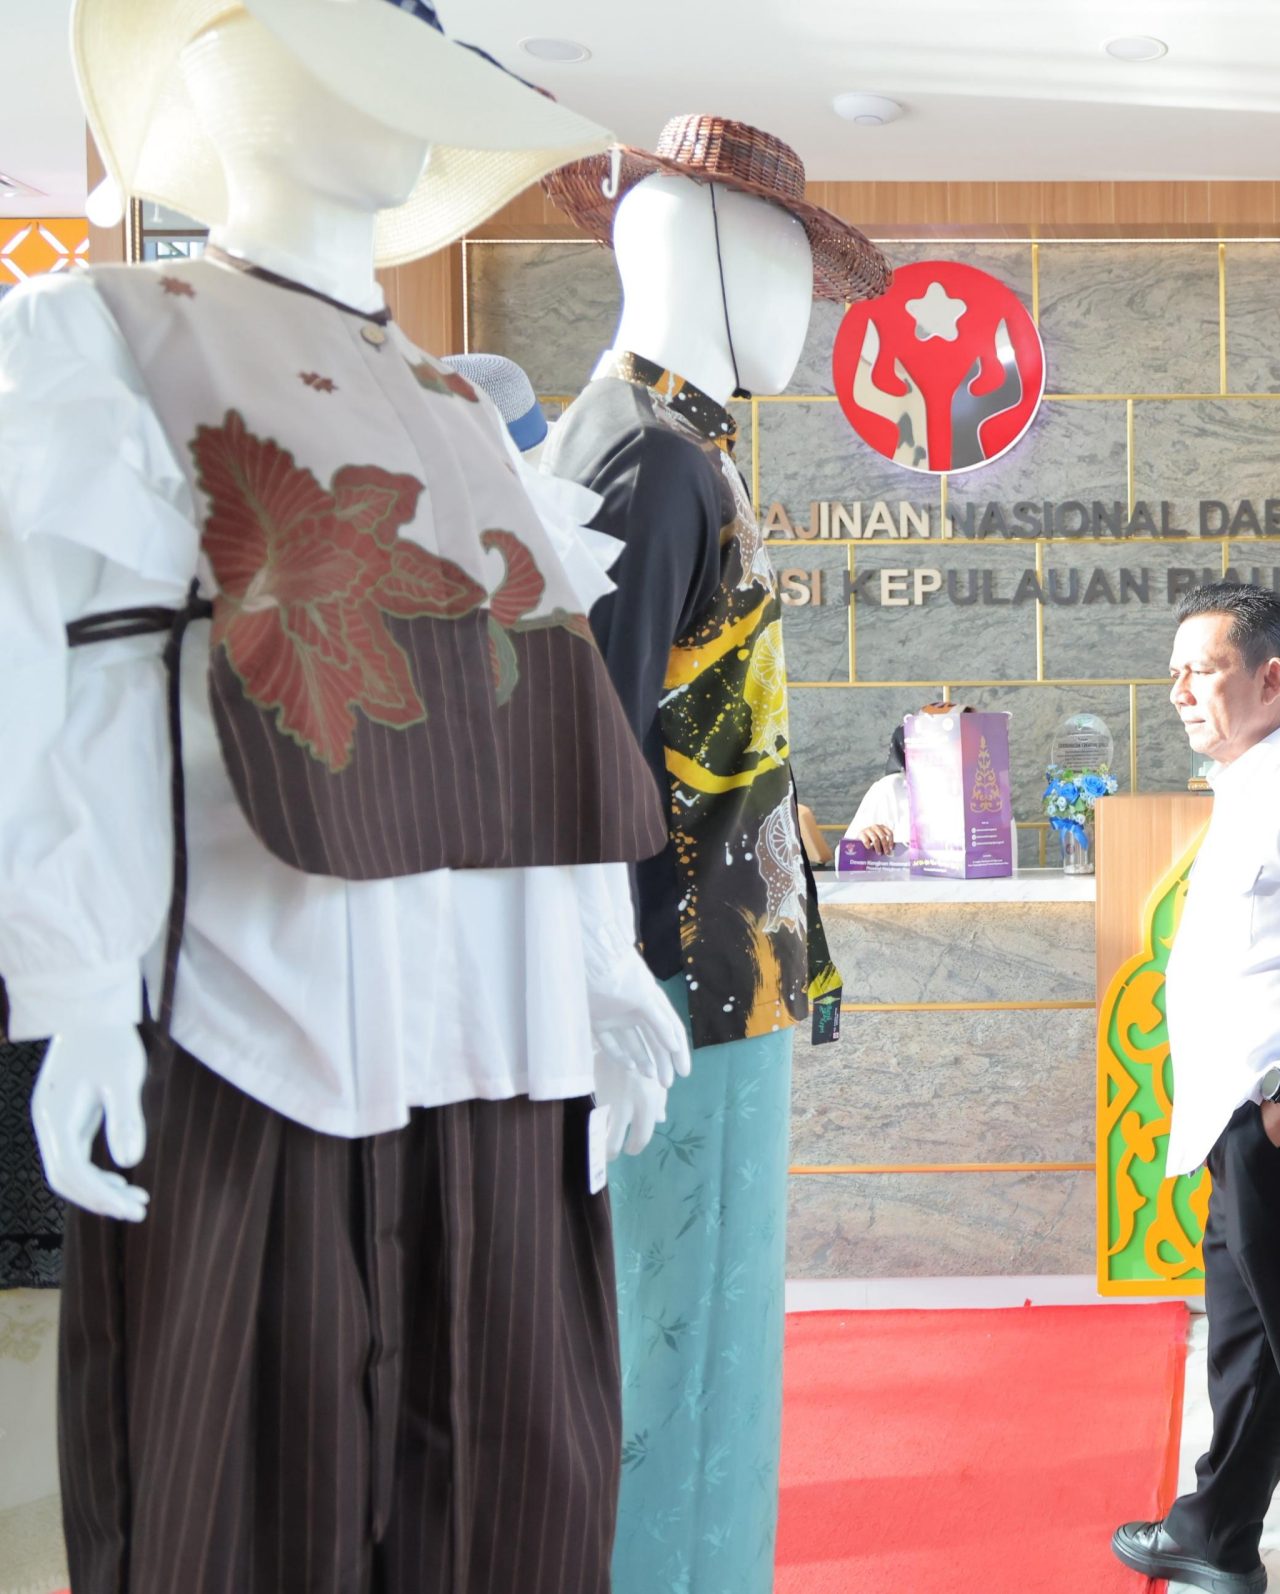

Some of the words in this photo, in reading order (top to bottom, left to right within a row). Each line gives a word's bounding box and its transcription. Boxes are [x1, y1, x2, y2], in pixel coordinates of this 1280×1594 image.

[946, 500, 1190, 538] NASIONAL
[777, 568, 821, 606] SI
[842, 567, 1149, 606] KEPULAUAN
